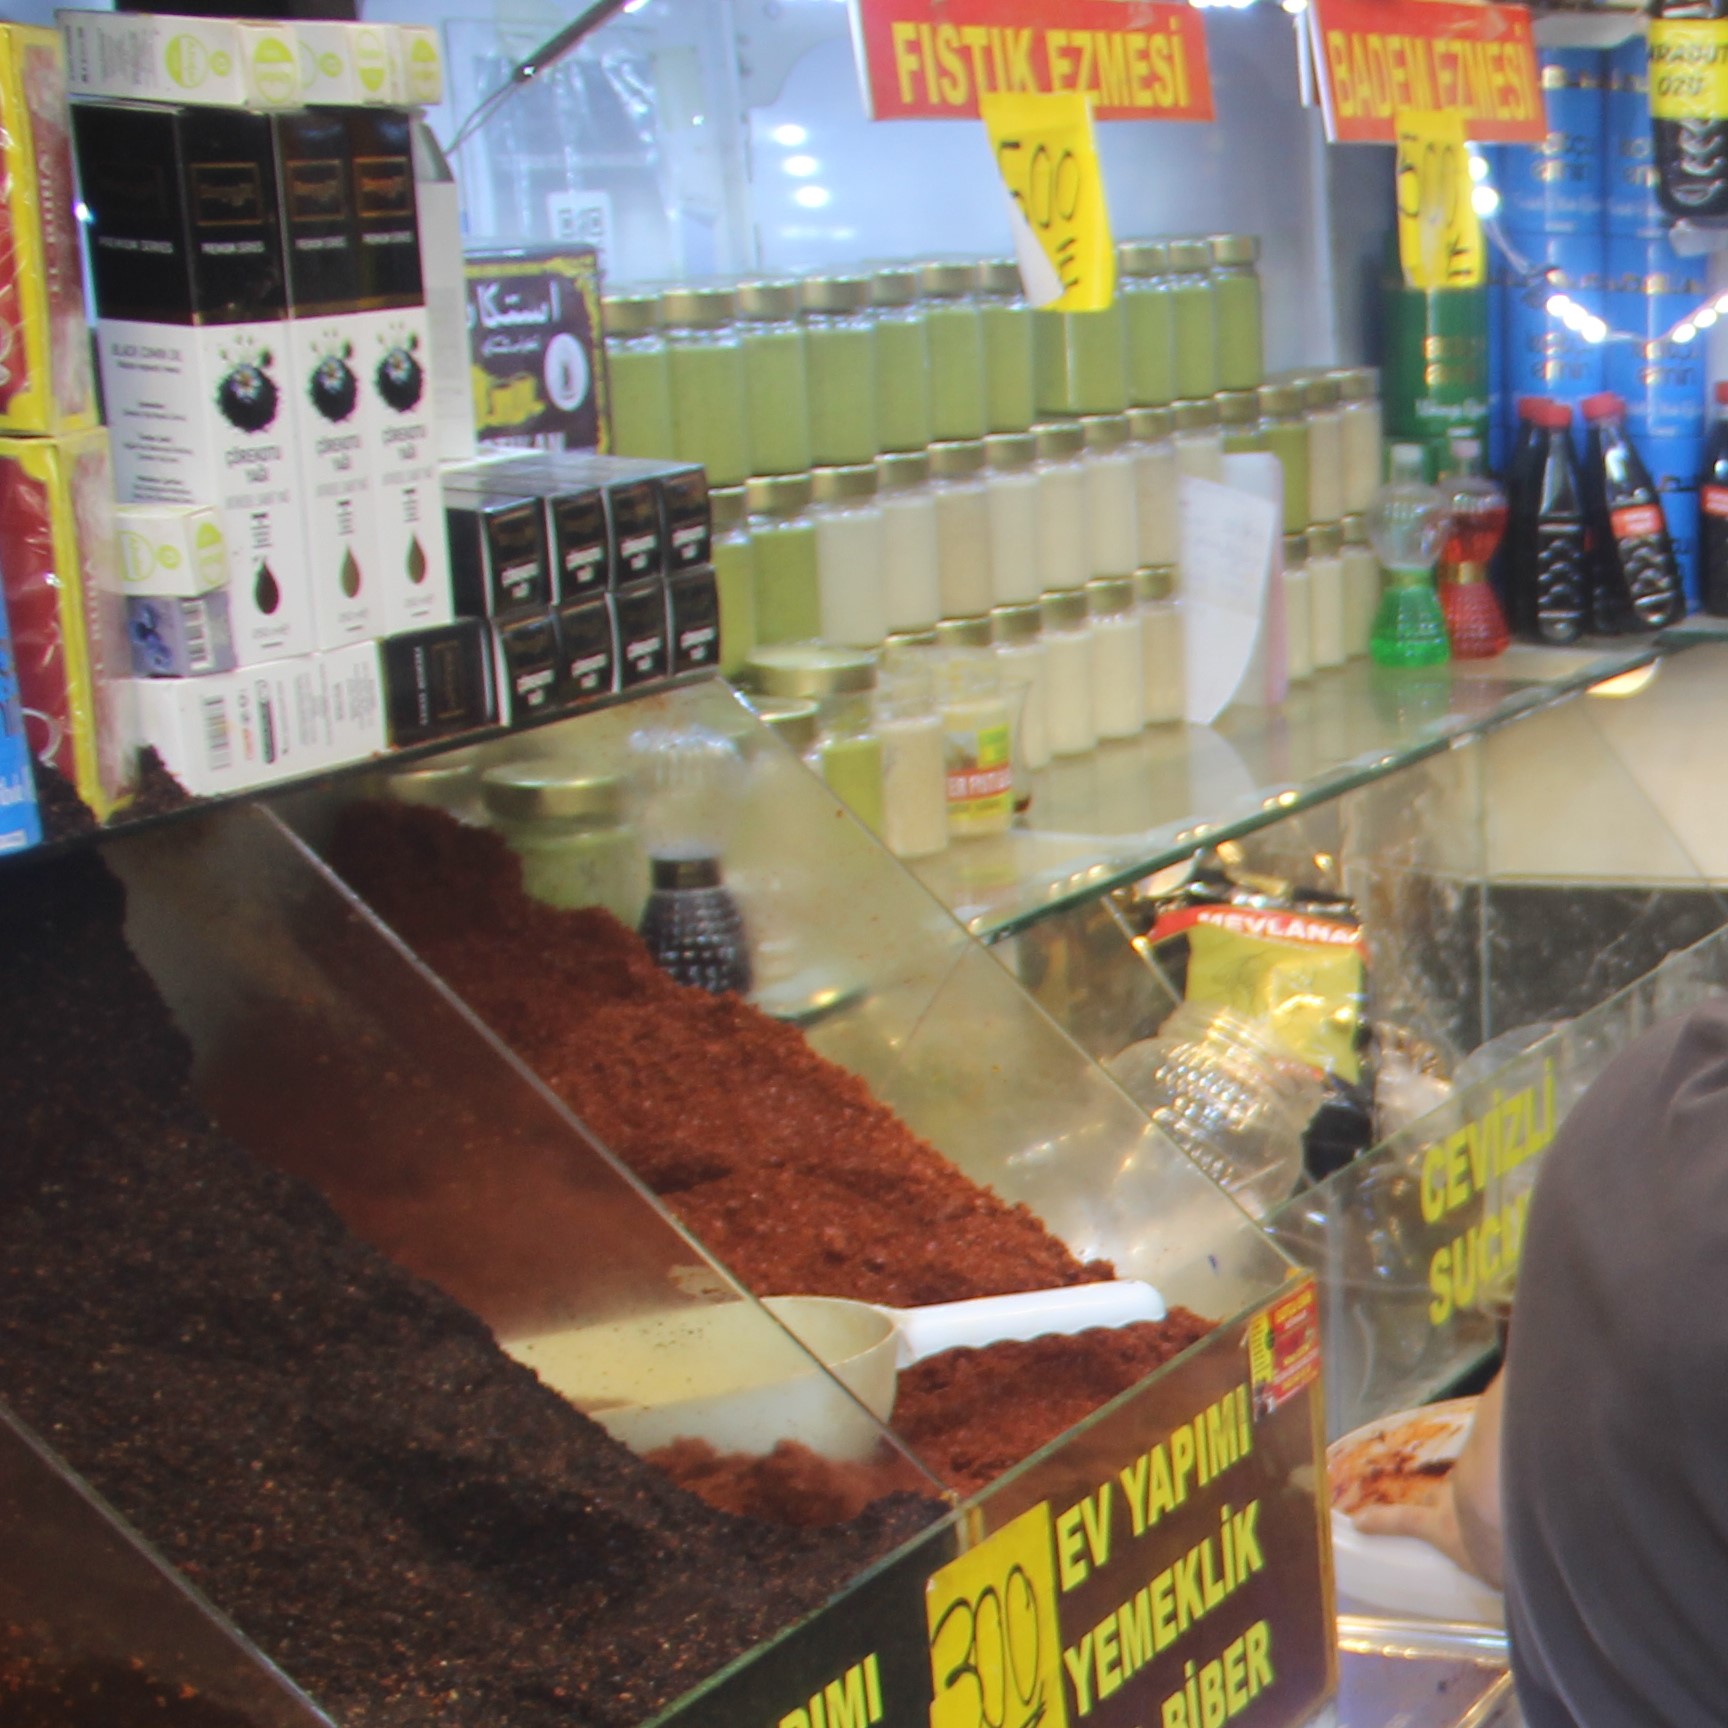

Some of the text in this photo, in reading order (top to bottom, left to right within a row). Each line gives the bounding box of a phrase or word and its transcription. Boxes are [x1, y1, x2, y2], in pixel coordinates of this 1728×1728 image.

[892, 20, 1189, 109] FISTIK EZMESİ
[1328, 25, 1532, 122] BADEM EZMESİ
[1057, 1384, 1252, 1592] EV YAPIMI
[1065, 1498, 1265, 1720] YEMEKLİK
